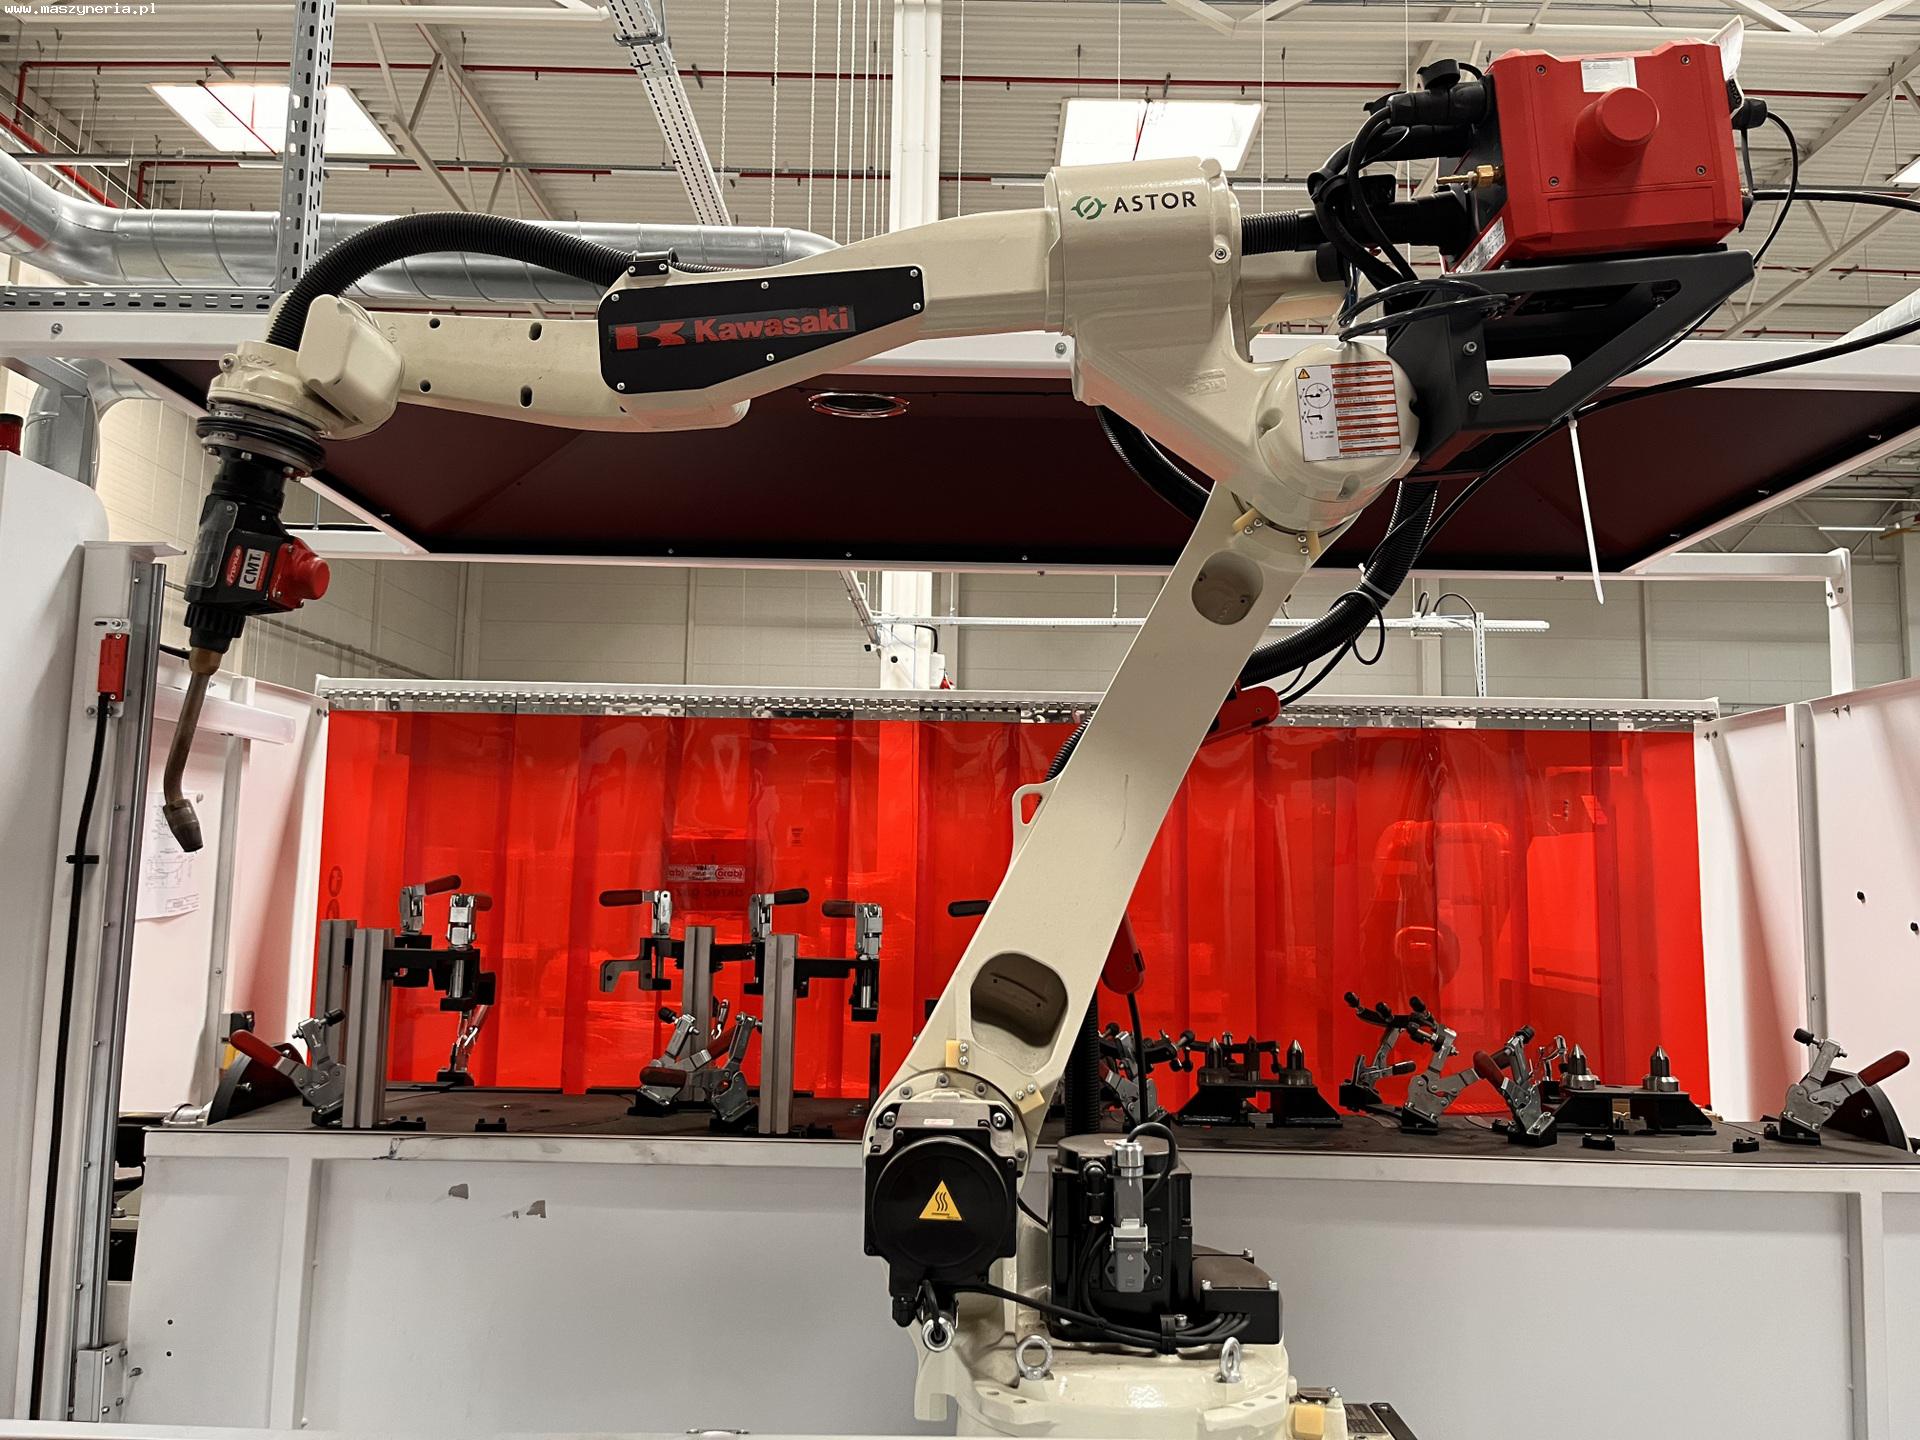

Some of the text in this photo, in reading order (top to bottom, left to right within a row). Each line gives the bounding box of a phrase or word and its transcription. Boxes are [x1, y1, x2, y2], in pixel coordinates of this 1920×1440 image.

[1113, 191, 1197, 214] ASTOR
[694, 307, 849, 343] Kawasaki
[243, 553, 261, 584] CMT
